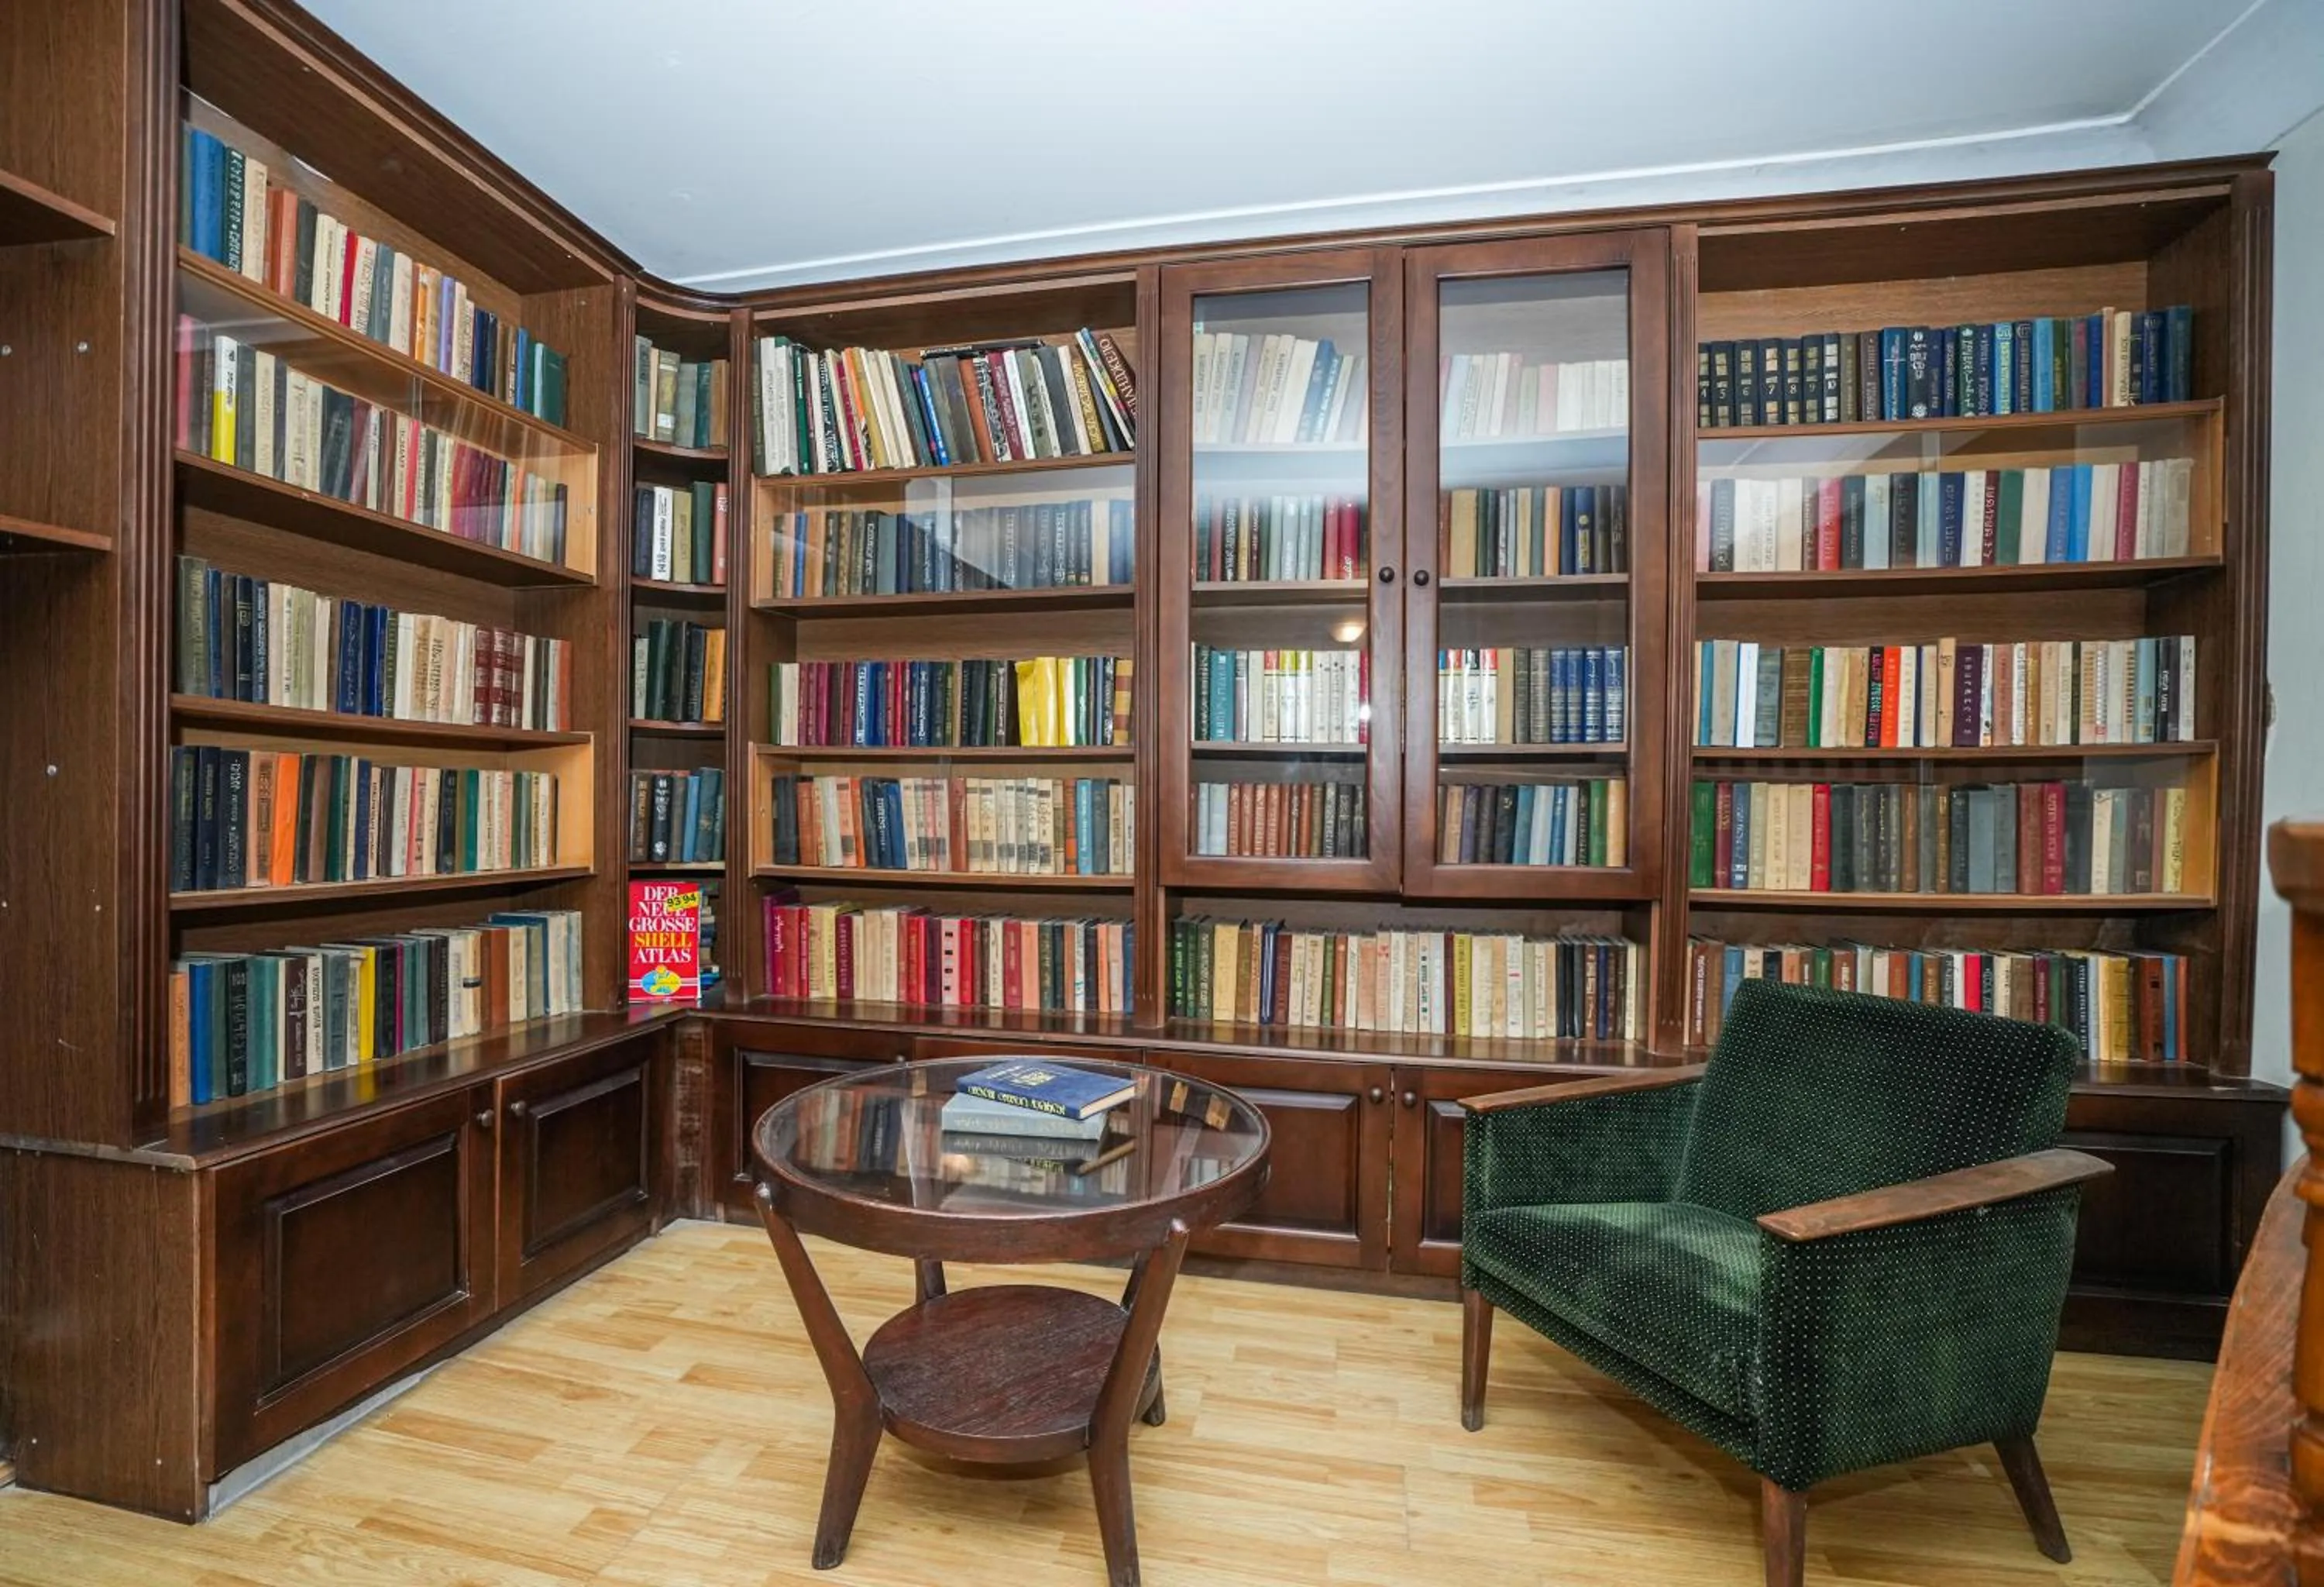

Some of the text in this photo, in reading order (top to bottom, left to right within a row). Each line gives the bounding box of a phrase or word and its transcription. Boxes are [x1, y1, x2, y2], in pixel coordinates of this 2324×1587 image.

[1099, 339, 1138, 417] ЕЛАНДЖЕЛО
[1719, 388, 1727, 399] 5
[1742, 387, 1750, 396] 6
[1768, 384, 1776, 395] 7
[1789, 384, 1797, 394] 8
[644, 886, 679, 901] DER
[628, 917, 696, 932] GROSSE
[634, 932, 692, 948] SHELL
[634, 948, 692, 963] ATLAS
